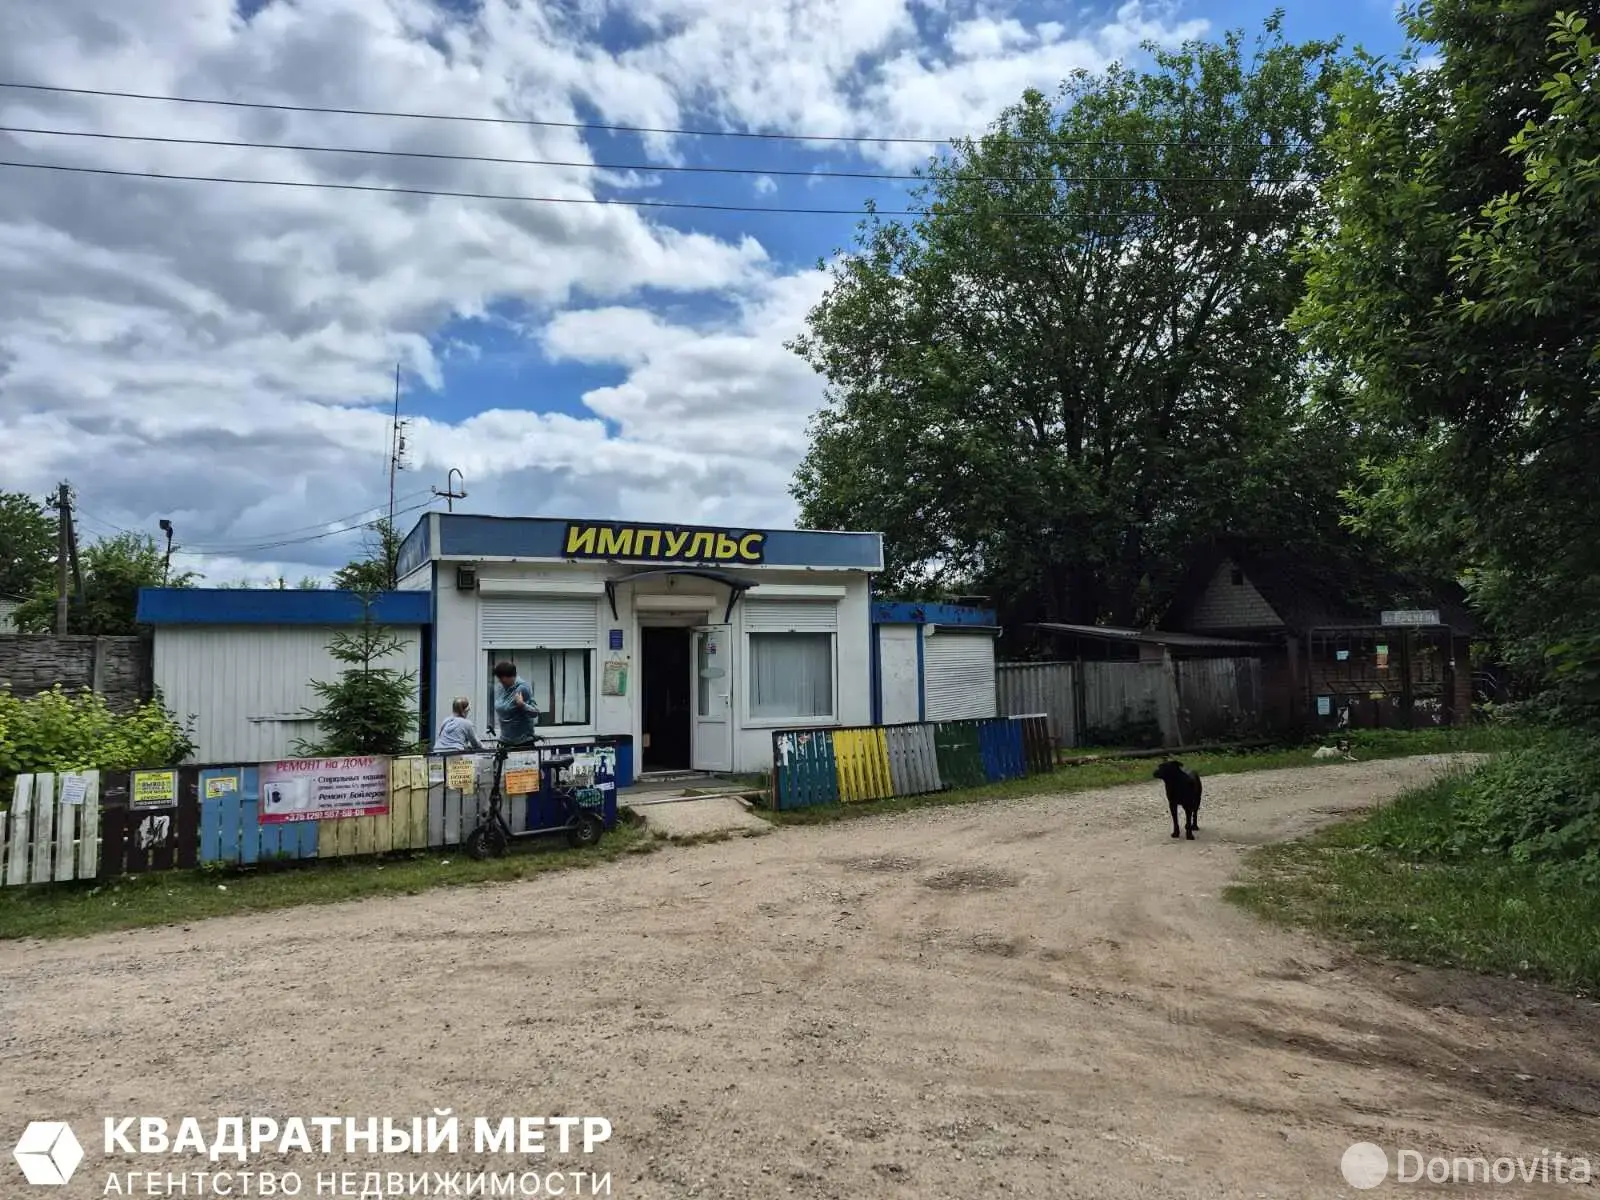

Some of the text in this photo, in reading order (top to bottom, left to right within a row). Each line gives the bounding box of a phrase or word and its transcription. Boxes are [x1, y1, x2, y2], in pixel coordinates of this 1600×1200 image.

[566, 526, 763, 560] ИМПУЛЬС
[276, 757, 375, 772] РЕМОНТ на ДОМУ
